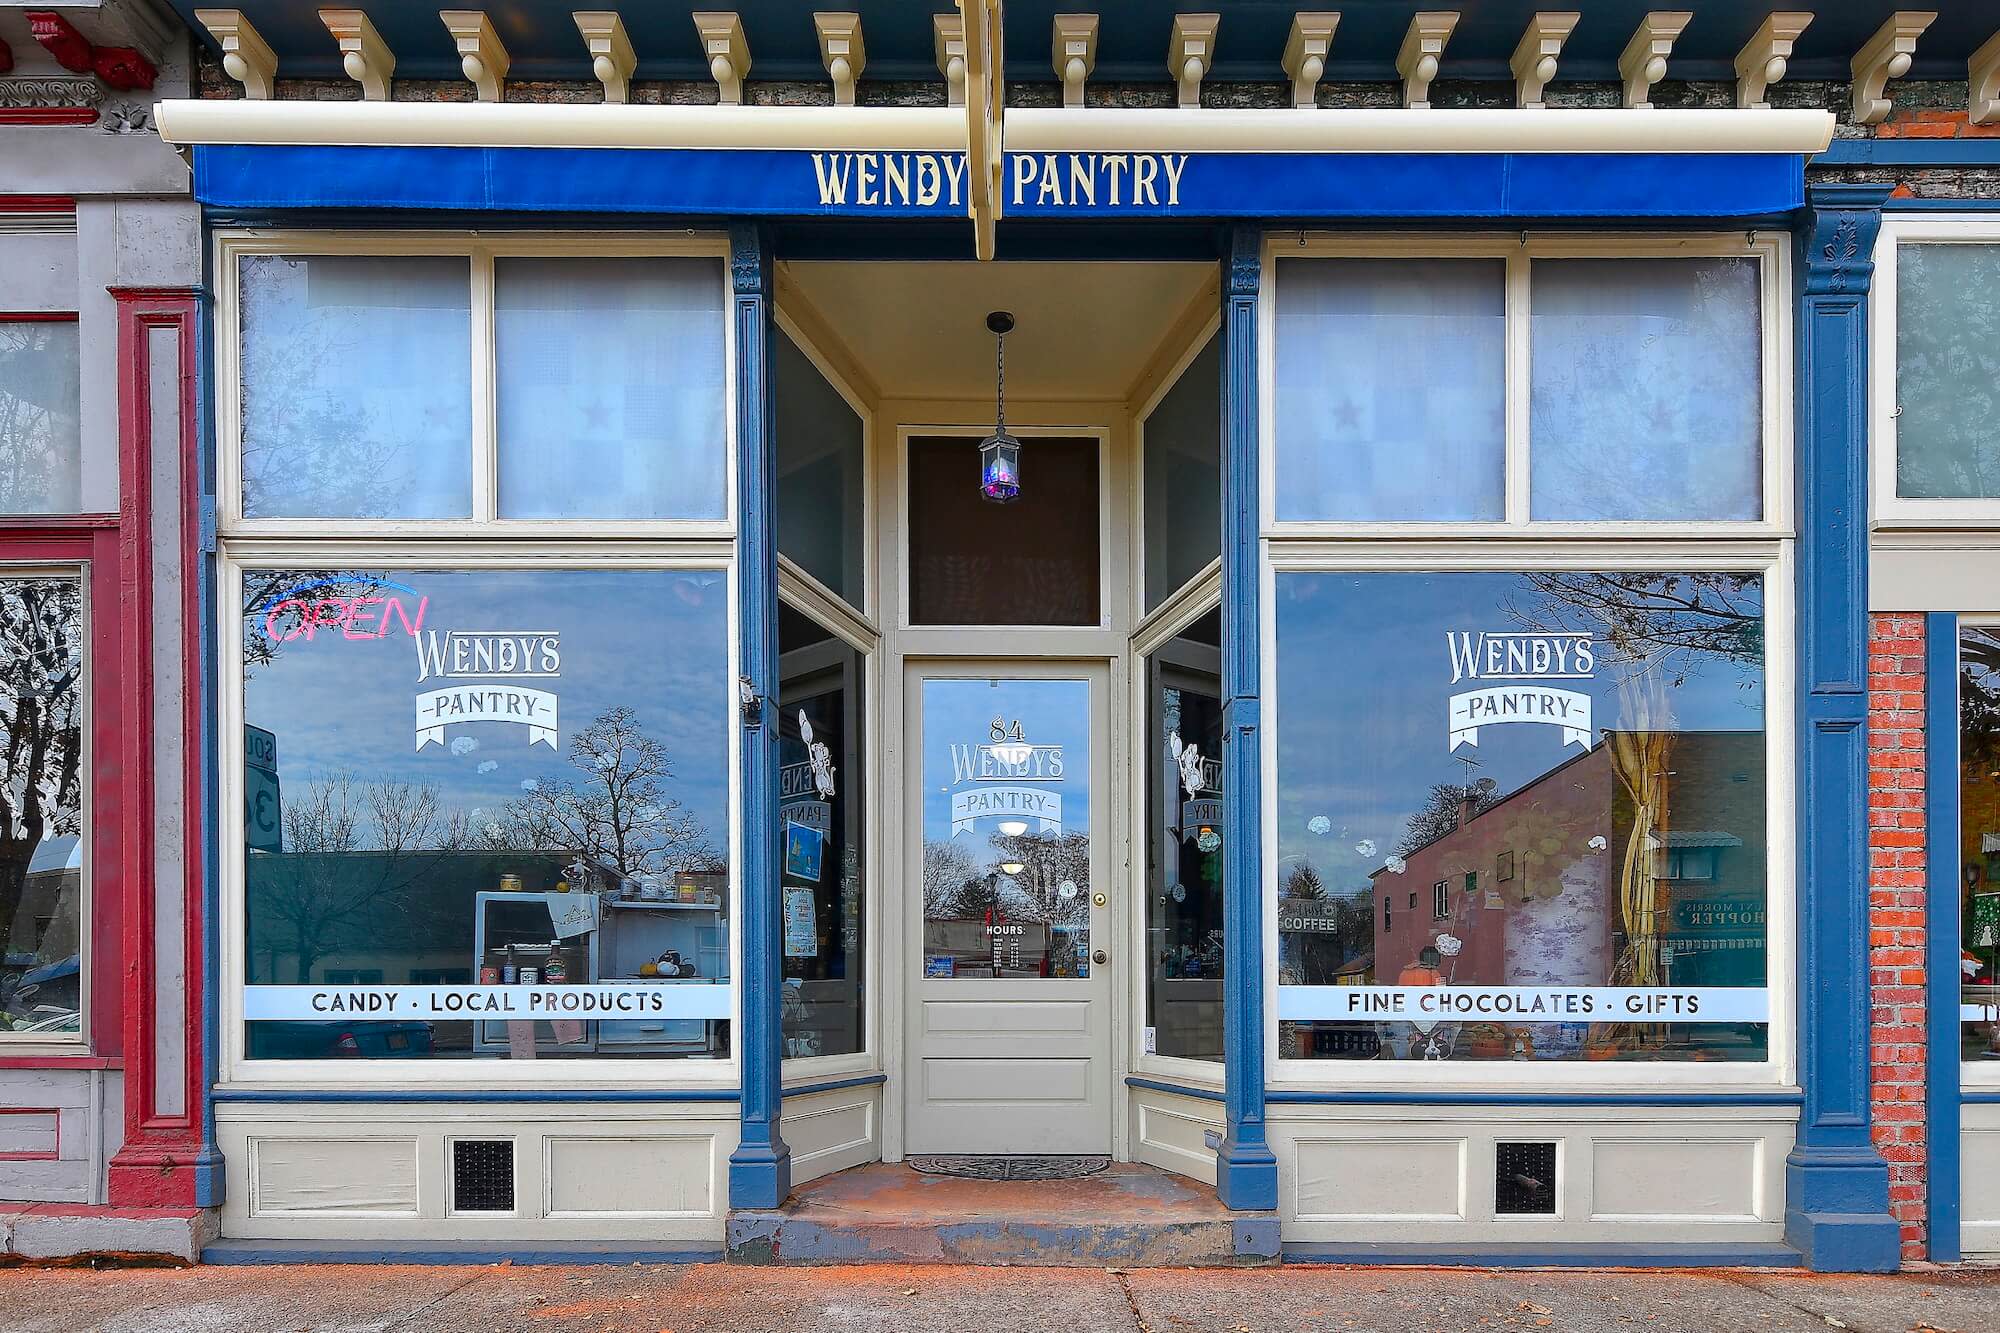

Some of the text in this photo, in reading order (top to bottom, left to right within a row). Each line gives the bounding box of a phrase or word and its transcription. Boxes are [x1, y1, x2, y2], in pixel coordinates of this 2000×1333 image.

[811, 153, 1189, 206] WENDY PANTRY
[266, 596, 429, 641] OPEN
[414, 630, 561, 683] WENDY'S
[1446, 631, 1595, 685] WENDY'S
[435, 692, 539, 718] PANTRY
[1469, 693, 1572, 720] PANTRY
[990, 715, 1026, 744] 84
[966, 792, 1047, 812] PANTRY
[986, 925, 1026, 935] HOURS:
[1284, 917, 1335, 931] COFFEE
[311, 992, 664, 1012] CANDY LOCAL PRODUCTS
[1349, 993, 1700, 1014] FINE CHOCOLATES GIFTS
